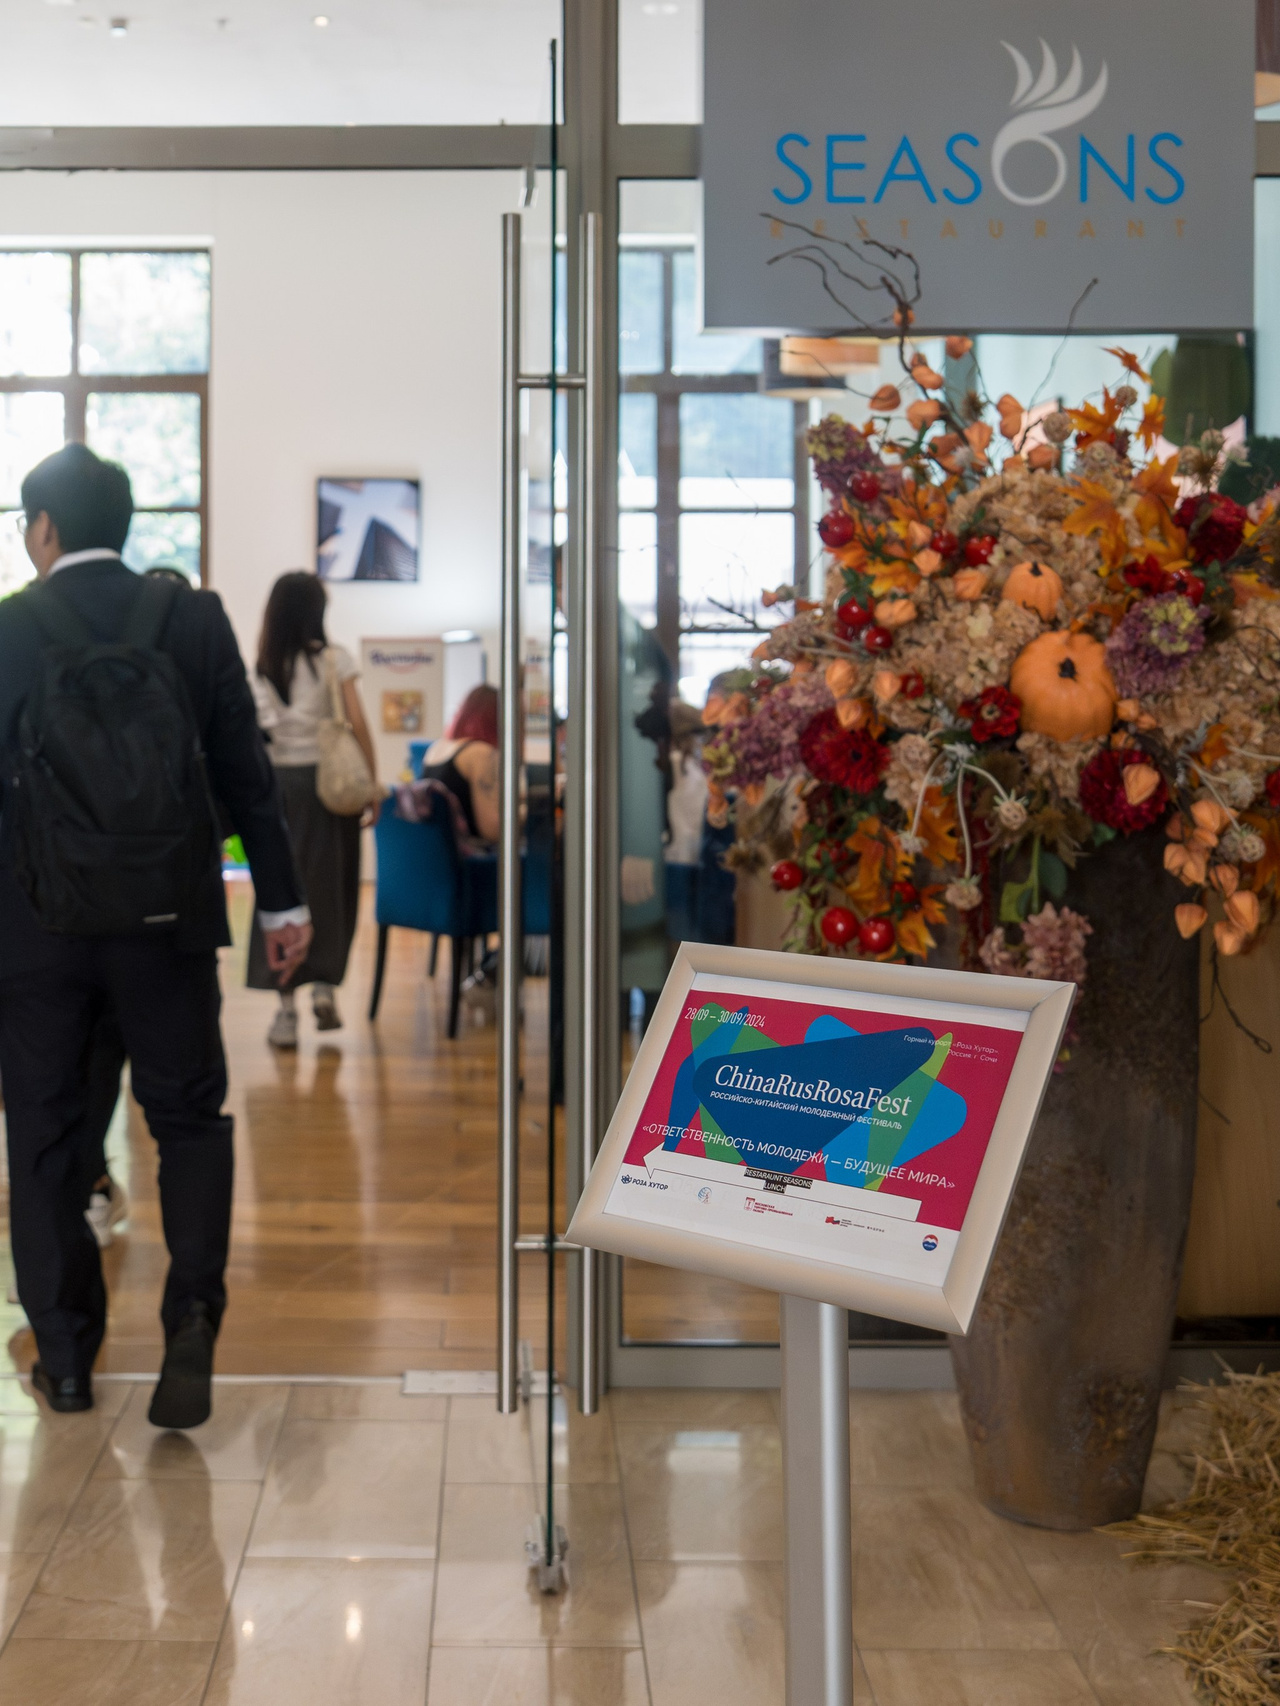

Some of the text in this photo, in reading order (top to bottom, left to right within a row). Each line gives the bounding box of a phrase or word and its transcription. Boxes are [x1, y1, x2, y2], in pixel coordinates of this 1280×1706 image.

[772, 131, 1186, 207] SEASONS
[769, 218, 1187, 240] RESTAURANT
[684, 1007, 710, 1021] 28/09
[717, 1010, 766, 1028] 30/09/2024
[714, 1064, 913, 1117] ChinaRusRosaFest
[709, 1090, 902, 1130] РОССИЙСКО-КИТАЙСКИЙ МОЛОДЕЖНЫЙ ФЕСТИВАЛЬ
[642, 1123, 755, 1151] «ОТВЕТСТВЕННОСТЬ
[756, 1142, 829, 1165] МОЛОДЕЖИ
[844, 1157, 907, 1180] БУДУЩЕЕ
[907, 1169, 956, 1189] МИРА»
[631, 1178, 669, 1190] РОЗА ХУТОР
[763, 1181, 787, 1192] LUNCH
[782, 1175, 813, 1188] SEASONS
